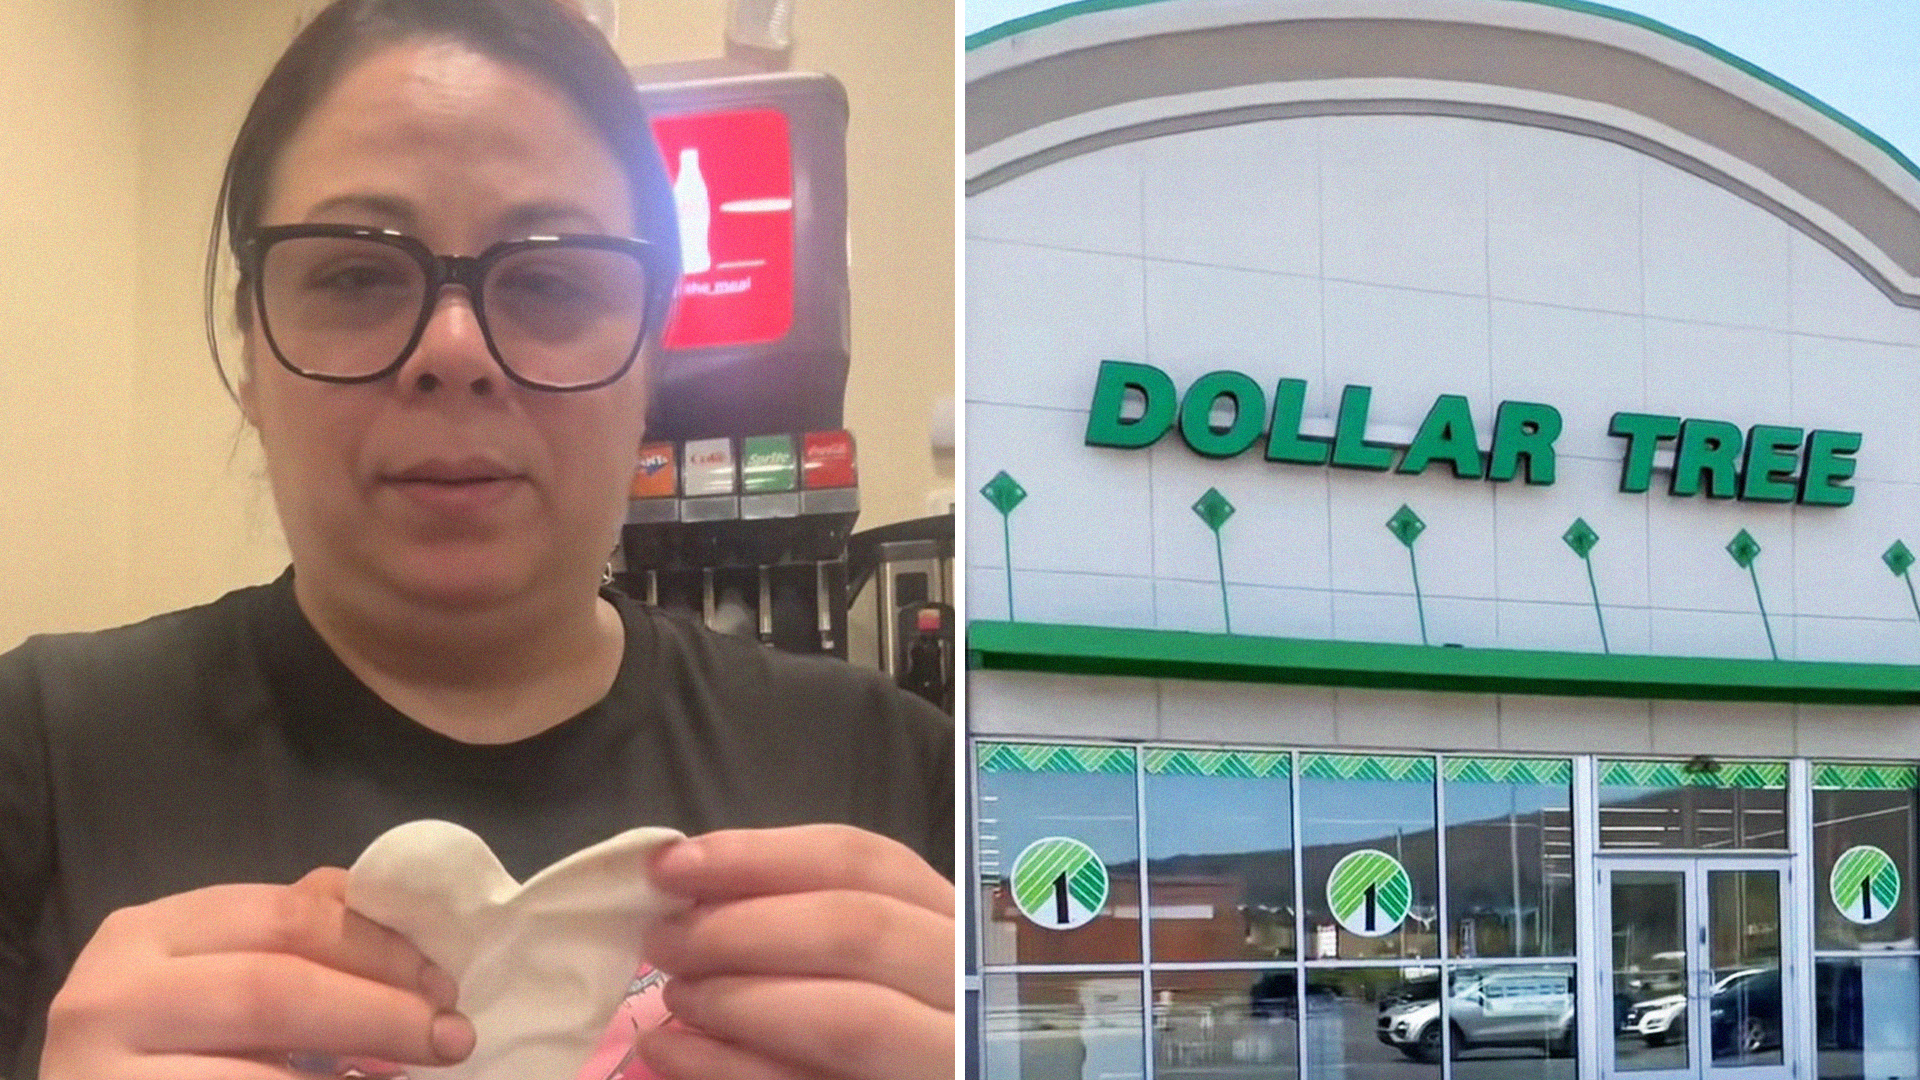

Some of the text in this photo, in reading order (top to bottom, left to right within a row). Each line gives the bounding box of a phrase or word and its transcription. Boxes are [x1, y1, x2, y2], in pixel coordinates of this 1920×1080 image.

[1084, 360, 1863, 508] DOLLAR TREE
[1052, 870, 1070, 924] 1
[1363, 882, 1376, 932] 1
[1860, 874, 1872, 919] 1
